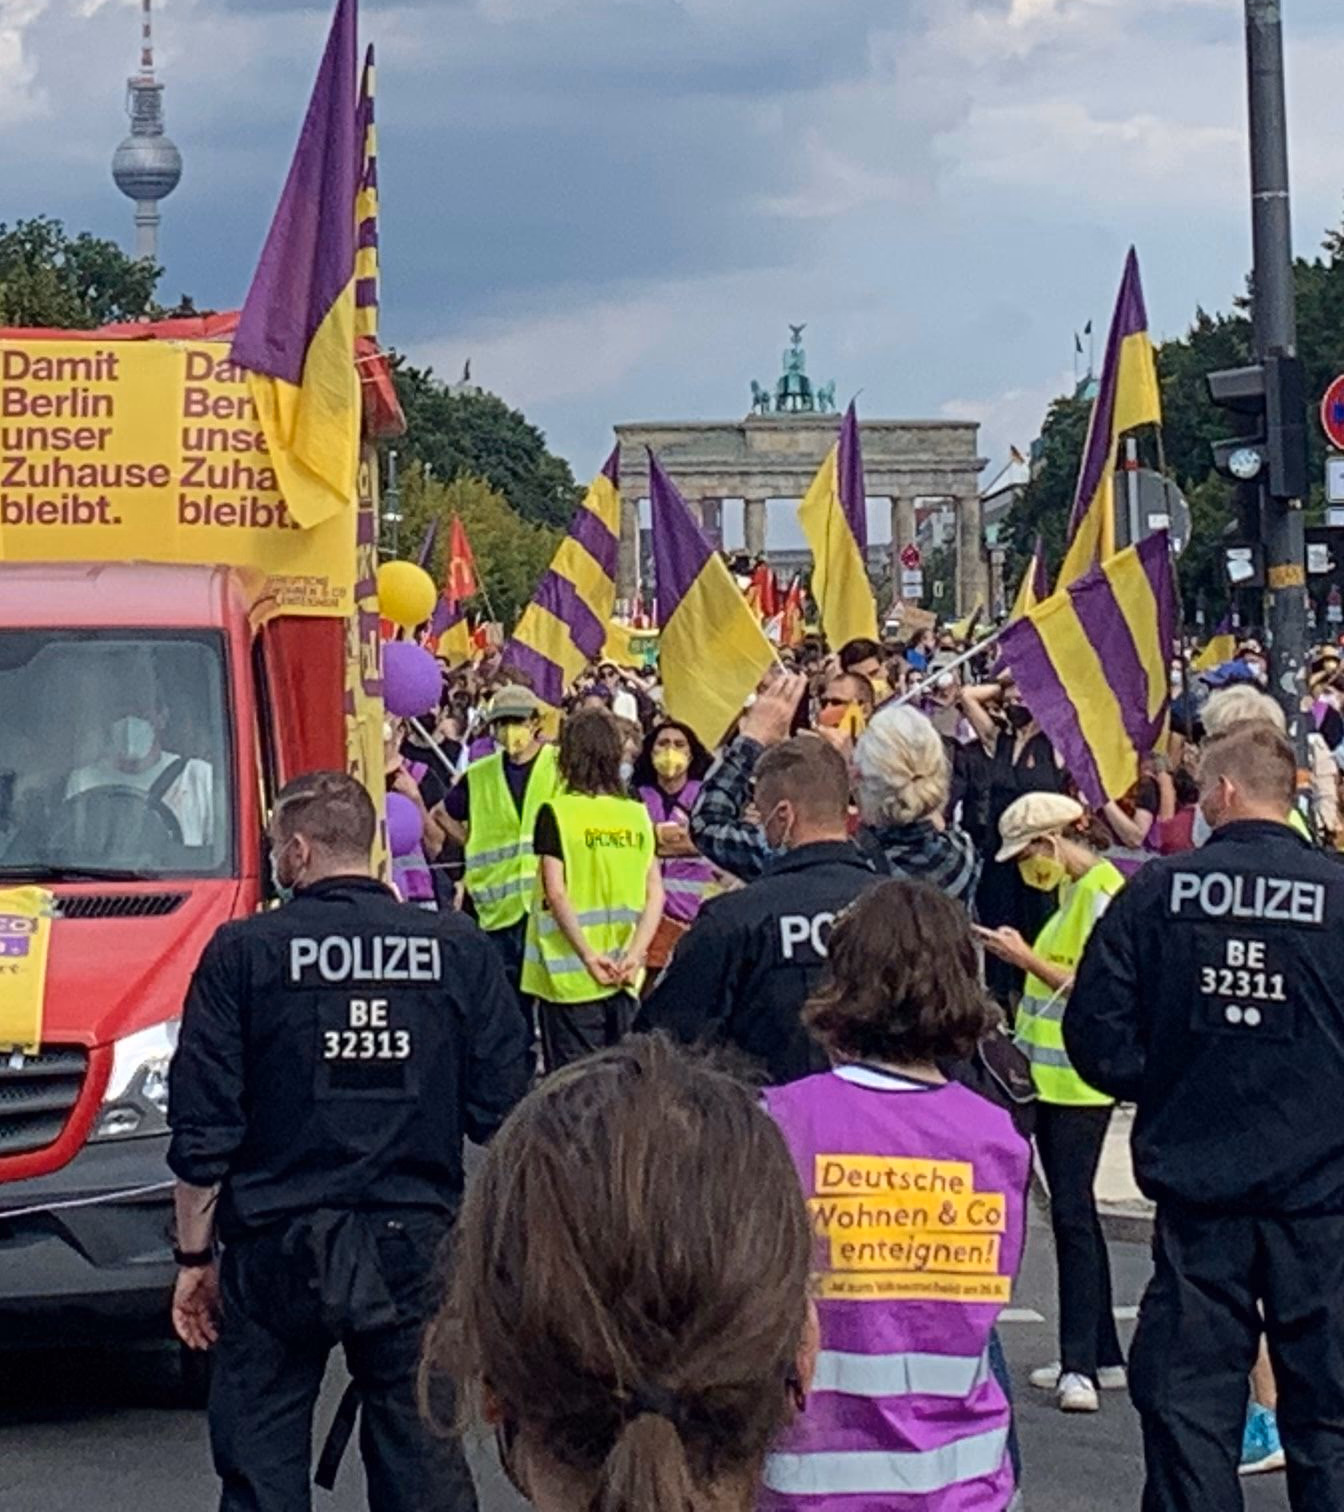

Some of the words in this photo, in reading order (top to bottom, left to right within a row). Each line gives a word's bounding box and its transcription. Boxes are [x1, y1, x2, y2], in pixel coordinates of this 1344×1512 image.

[2, 350, 119, 381] Damit
[1, 387, 114, 418] Berlin
[184, 387, 259, 421] Ber
[1, 426, 112, 452] unser
[182, 427, 270, 455] unse
[0, 456, 170, 488] Zuhause
[179, 457, 279, 491] Zuha
[0, 493, 122, 525] bleibt.
[178, 493, 300, 530] bleibt.
[1170, 871, 1325, 923] POLIZEI
[290, 936, 441, 981] POLIZEI
[1226, 940, 1266, 968] BE
[1200, 967, 1286, 1001] 32311
[350, 999, 387, 1027] BE
[323, 1031, 410, 1059] 32313
[822, 1161, 965, 1194] Deutsche
[813, 1202, 929, 1229] Wohnen
[938, 1200, 957, 1226] &
[966, 1199, 1002, 1227] Co
[840, 1236, 994, 1271] enteignen!
